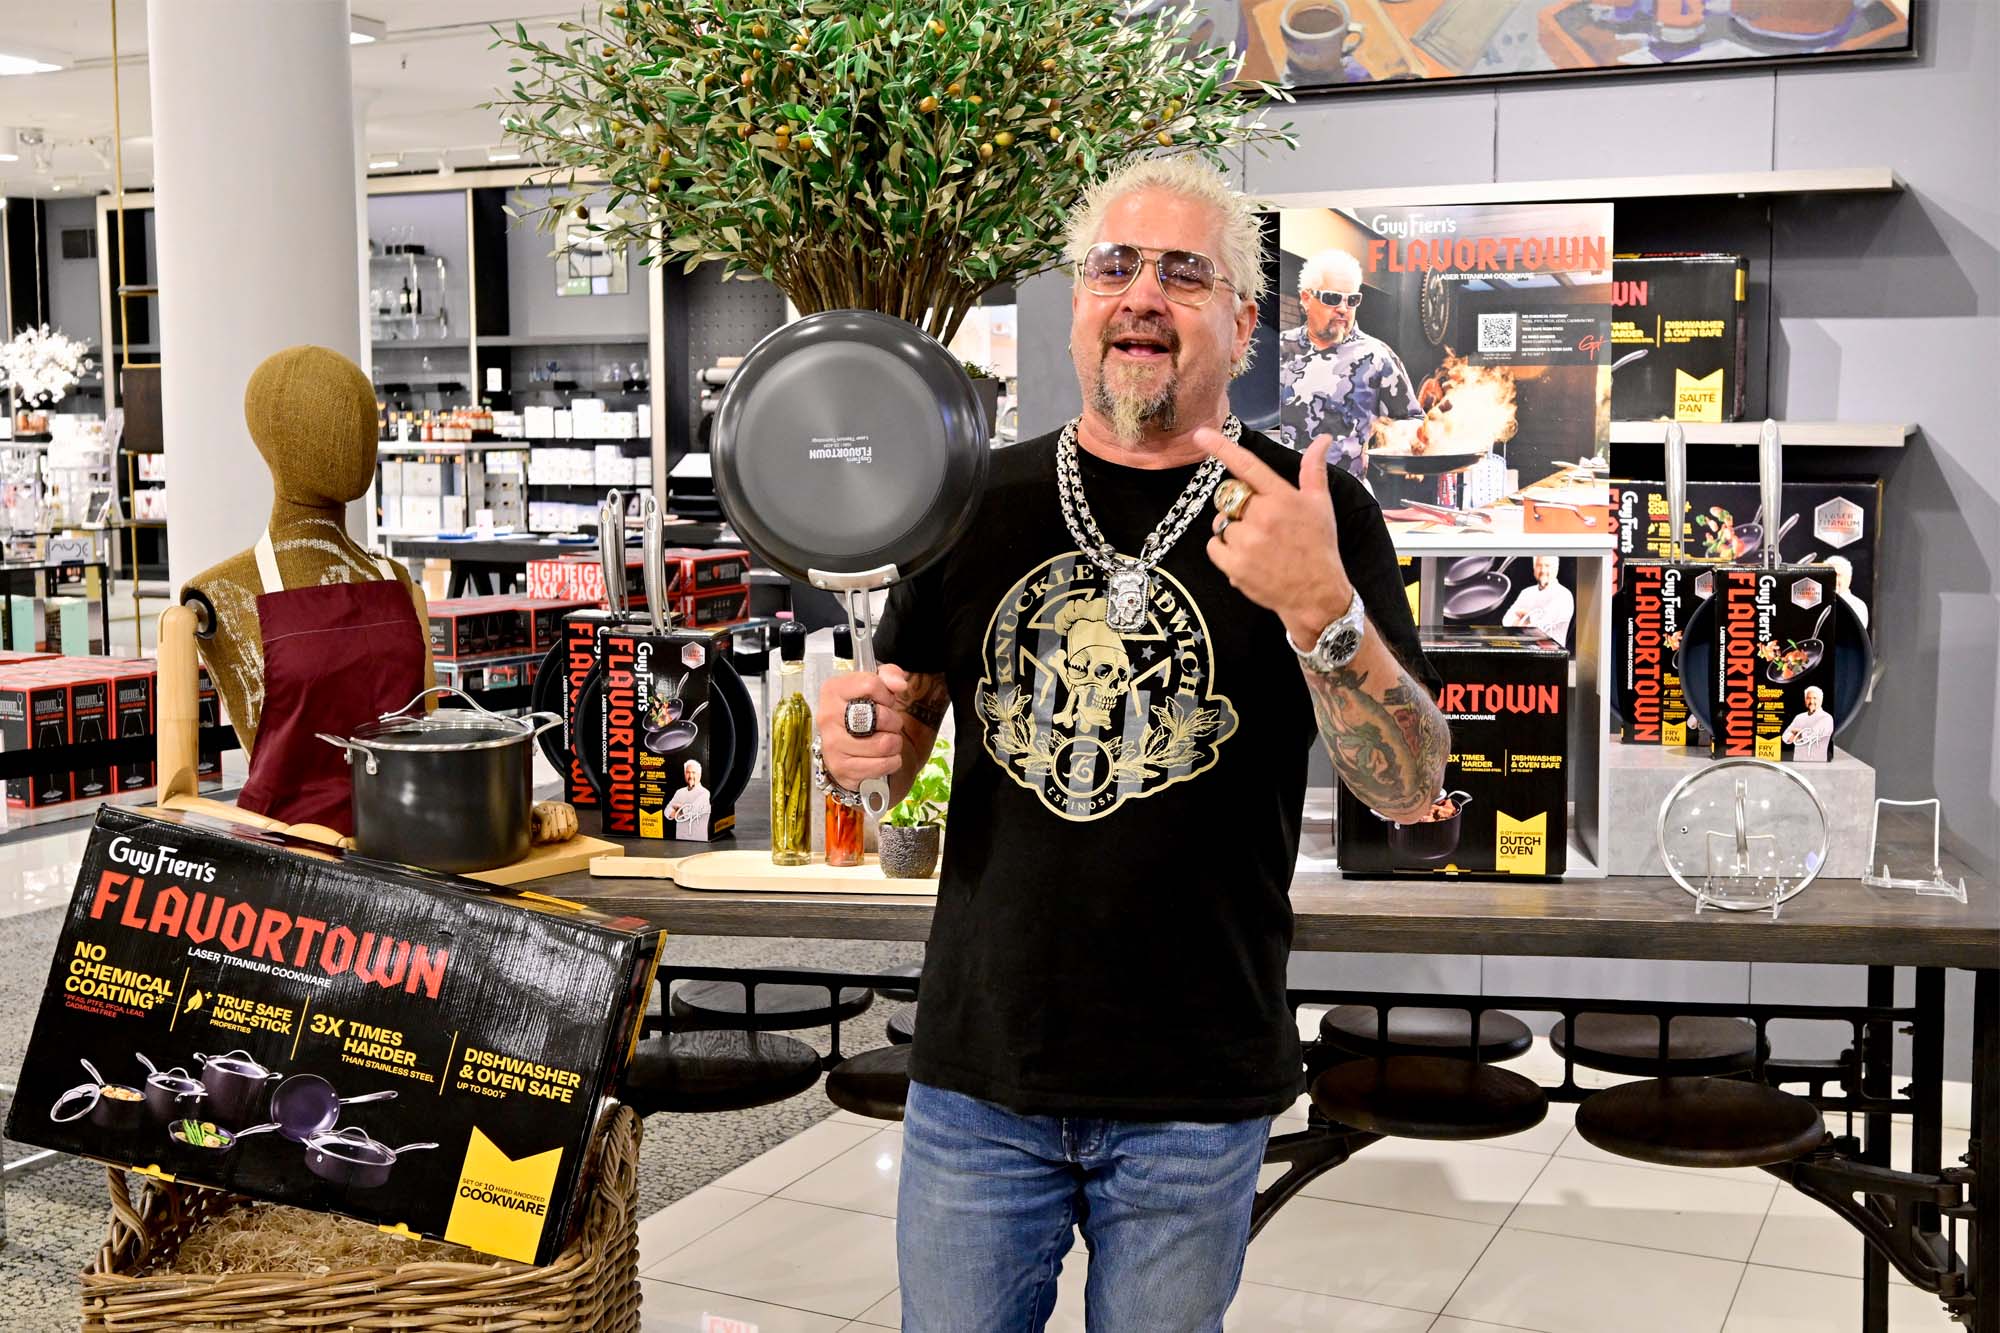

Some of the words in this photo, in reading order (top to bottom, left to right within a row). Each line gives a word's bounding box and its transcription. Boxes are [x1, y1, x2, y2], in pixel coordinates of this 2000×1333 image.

[1372, 215, 1408, 238] Guy
[1409, 215, 1456, 235] Fieri's
[1368, 236, 1606, 272] FLAVORTOWN
[1494, 272, 1535, 280] COOKWARE
[1678, 404, 1702, 412] PAN
[809, 446, 872, 459] FLAVORTOWN
[1618, 491, 1638, 518] Guy
[528, 580, 558, 599] PACK
[570, 583, 602, 601] PACK
[1662, 569, 1681, 596] Guy
[1756, 576, 1776, 604] Guy
[997, 564, 1094, 684] KNUCKLE
[1662, 596, 1681, 632] Fieri's
[1756, 604, 1776, 642] Fieri's
[634, 642, 653, 674] Guy
[1634, 566, 1661, 742] FLAVORTOWN
[1726, 572, 1756, 756] FLAVORTOWN
[636, 673, 653, 712] Fieri's
[608, 638, 634, 832] FLAVORTOWN
[1047, 786, 1114, 810] ESPINOSA
[1500, 836, 1541, 846] DUTCH
[1500, 846, 1534, 855] OVEN
[108, 836, 155, 875] Guy
[154, 845, 217, 882] Fieri's
[90, 870, 450, 1000] FLAVORTOWN
[74, 941, 107, 962] NO
[70, 958, 174, 998] CHEMICAL
[188, 946, 220, 962] LASER
[222, 954, 270, 974] TITANIUM
[271, 966, 332, 988] COOKWARE
[100, 1008, 117, 1018] FREE
[212, 1006, 292, 1035] NON-STICK
[217, 993, 256, 1012] TRUE
[256, 1002, 293, 1022] SAFE
[209, 1019, 252, 1034] PROPERTIES
[310, 1014, 344, 1038] 3X
[349, 1022, 404, 1044] TIMES
[343, 1037, 417, 1068] HARDER
[342, 1054, 364, 1068] THAN
[364, 1059, 409, 1078] STAINLESS
[410, 1070, 435, 1083] STEEL
[464, 1048, 581, 1088] DISHWASHER
[456, 1081, 469, 1090] UP
[470, 1084, 482, 1094] TO
[459, 1064, 474, 1080] &
[477, 1068, 526, 1092] OVEN
[528, 1080, 574, 1104] SAFE
[460, 1186, 546, 1217] COOKWARE
[462, 1178, 474, 1186] SET
[484, 1182, 494, 1192] 10
[496, 1186, 513, 1196] HARD
[514, 1190, 546, 1202] ANODIZED
